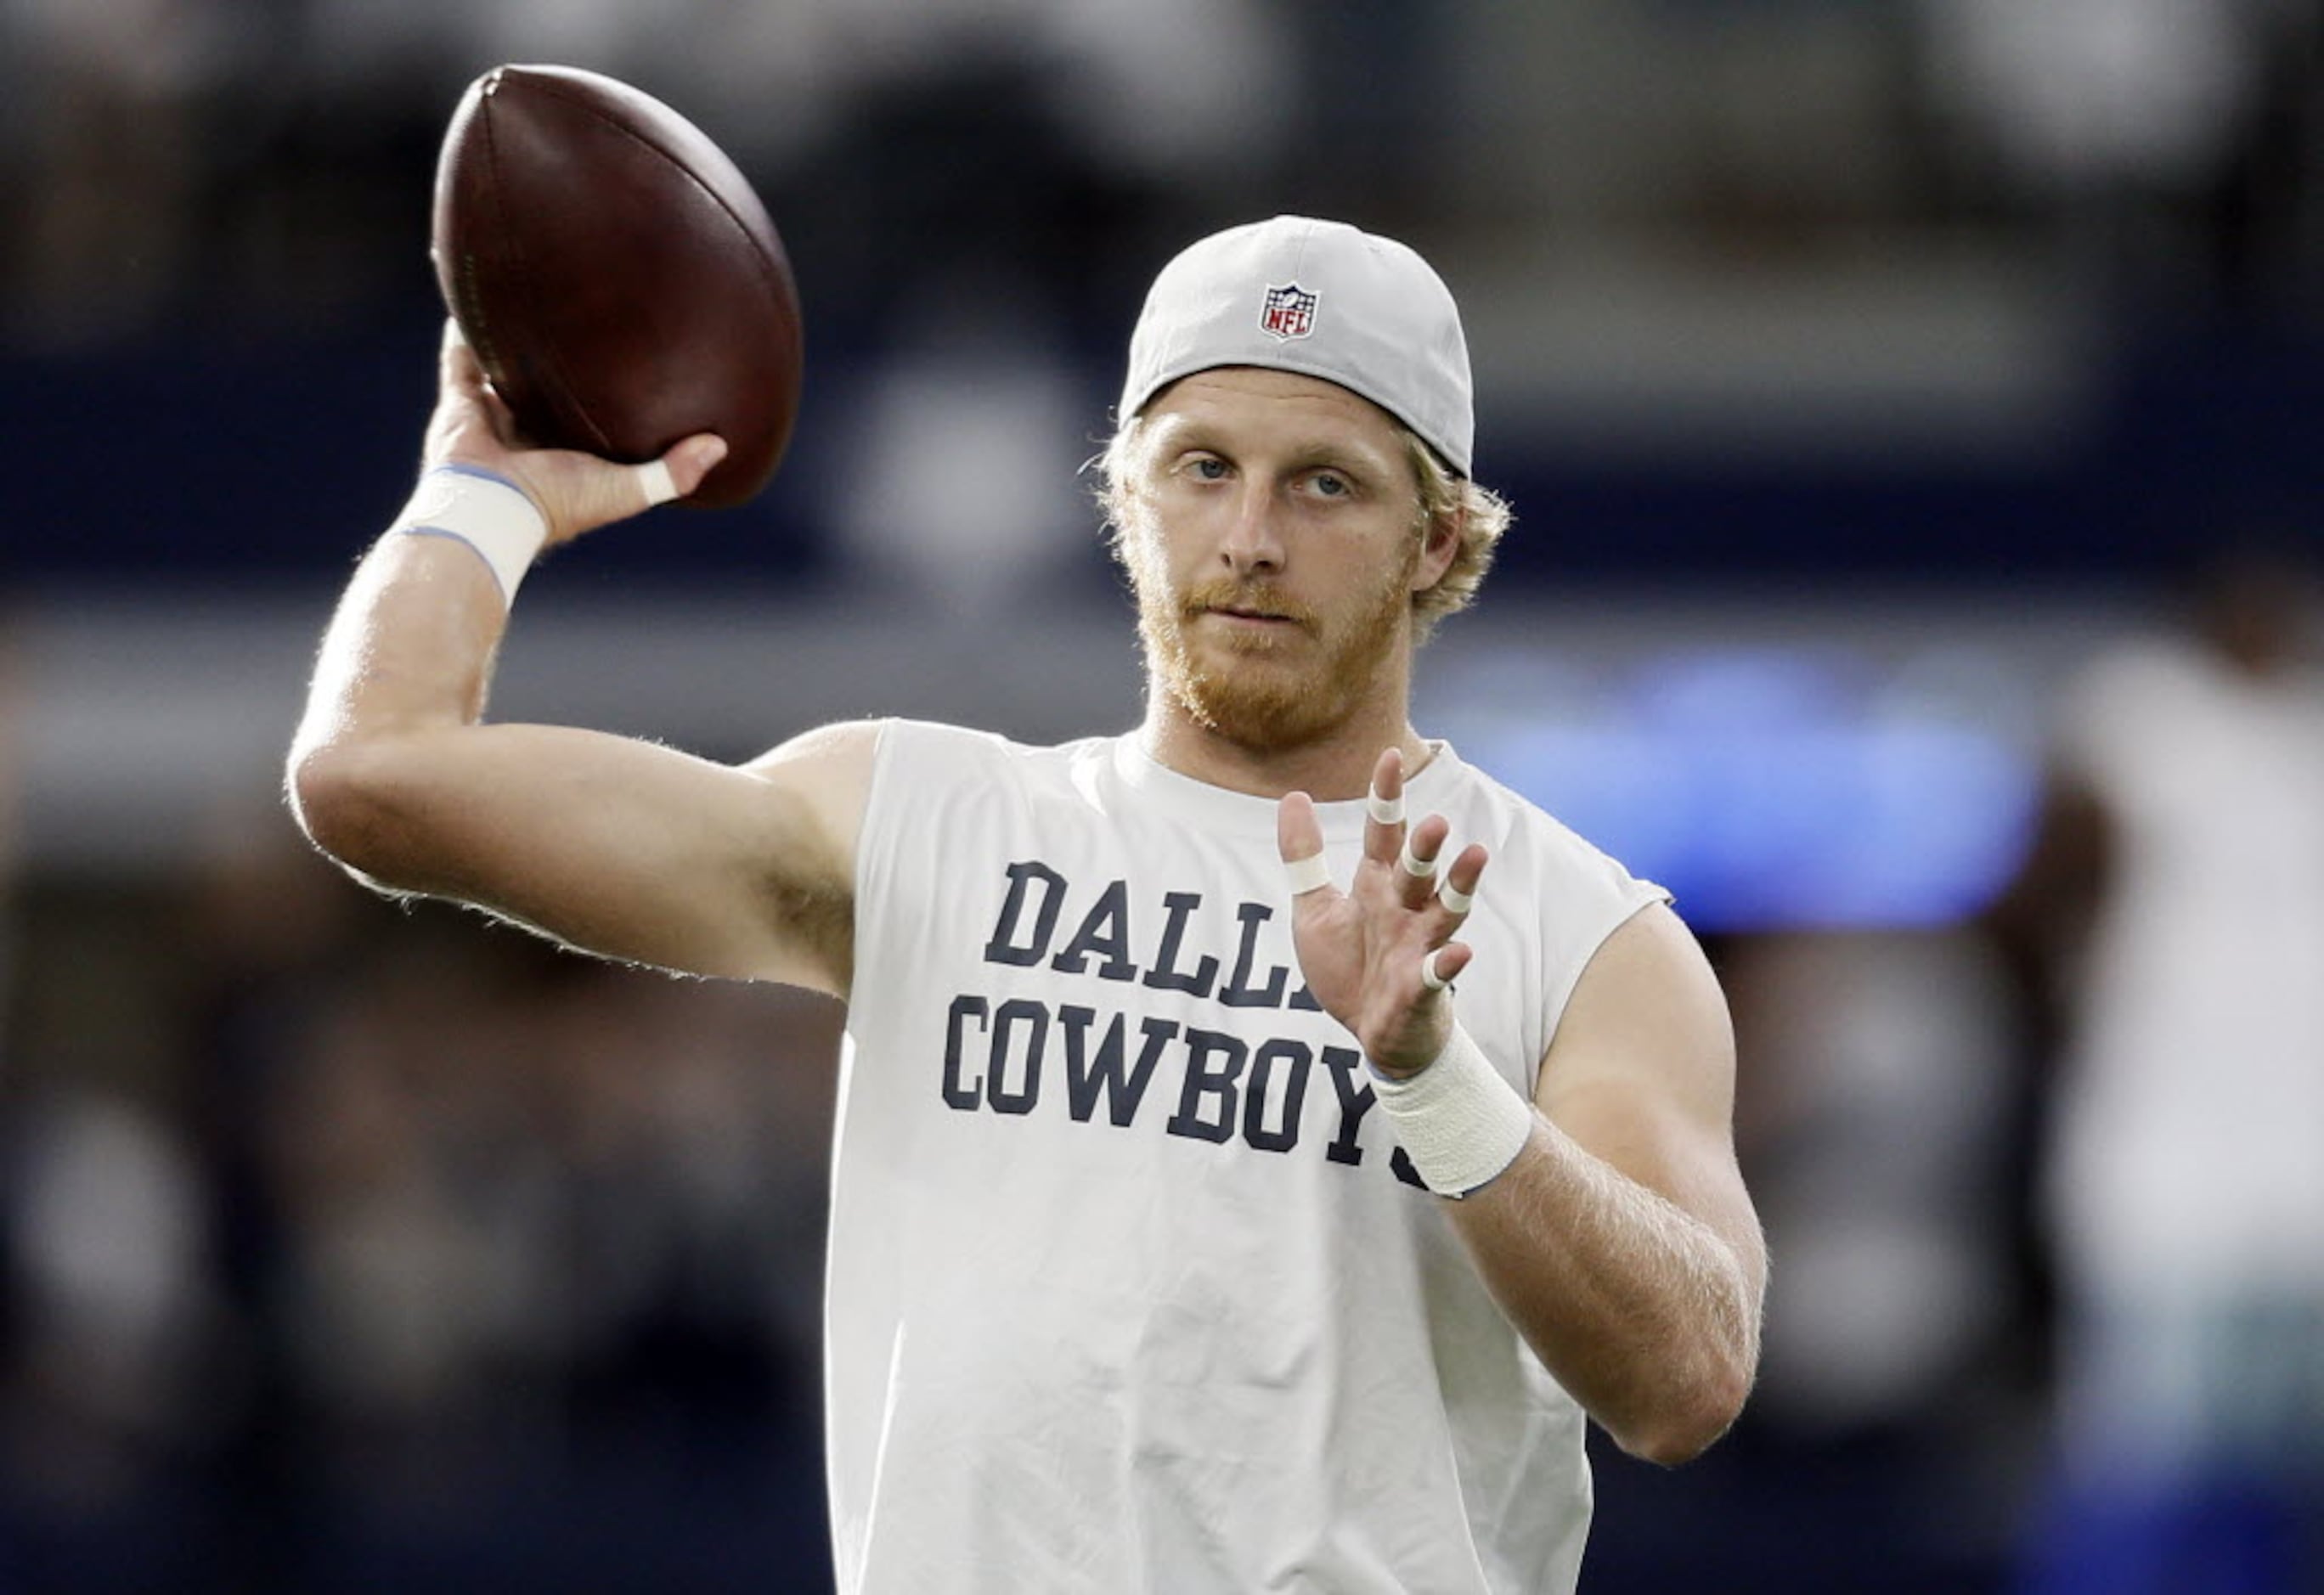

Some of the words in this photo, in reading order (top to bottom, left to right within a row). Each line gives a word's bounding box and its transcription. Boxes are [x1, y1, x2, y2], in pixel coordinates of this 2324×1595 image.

[1266, 307, 1307, 334] NFL
[984, 859, 1455, 1012] DALL
[941, 995, 1430, 1190] COWBOY
